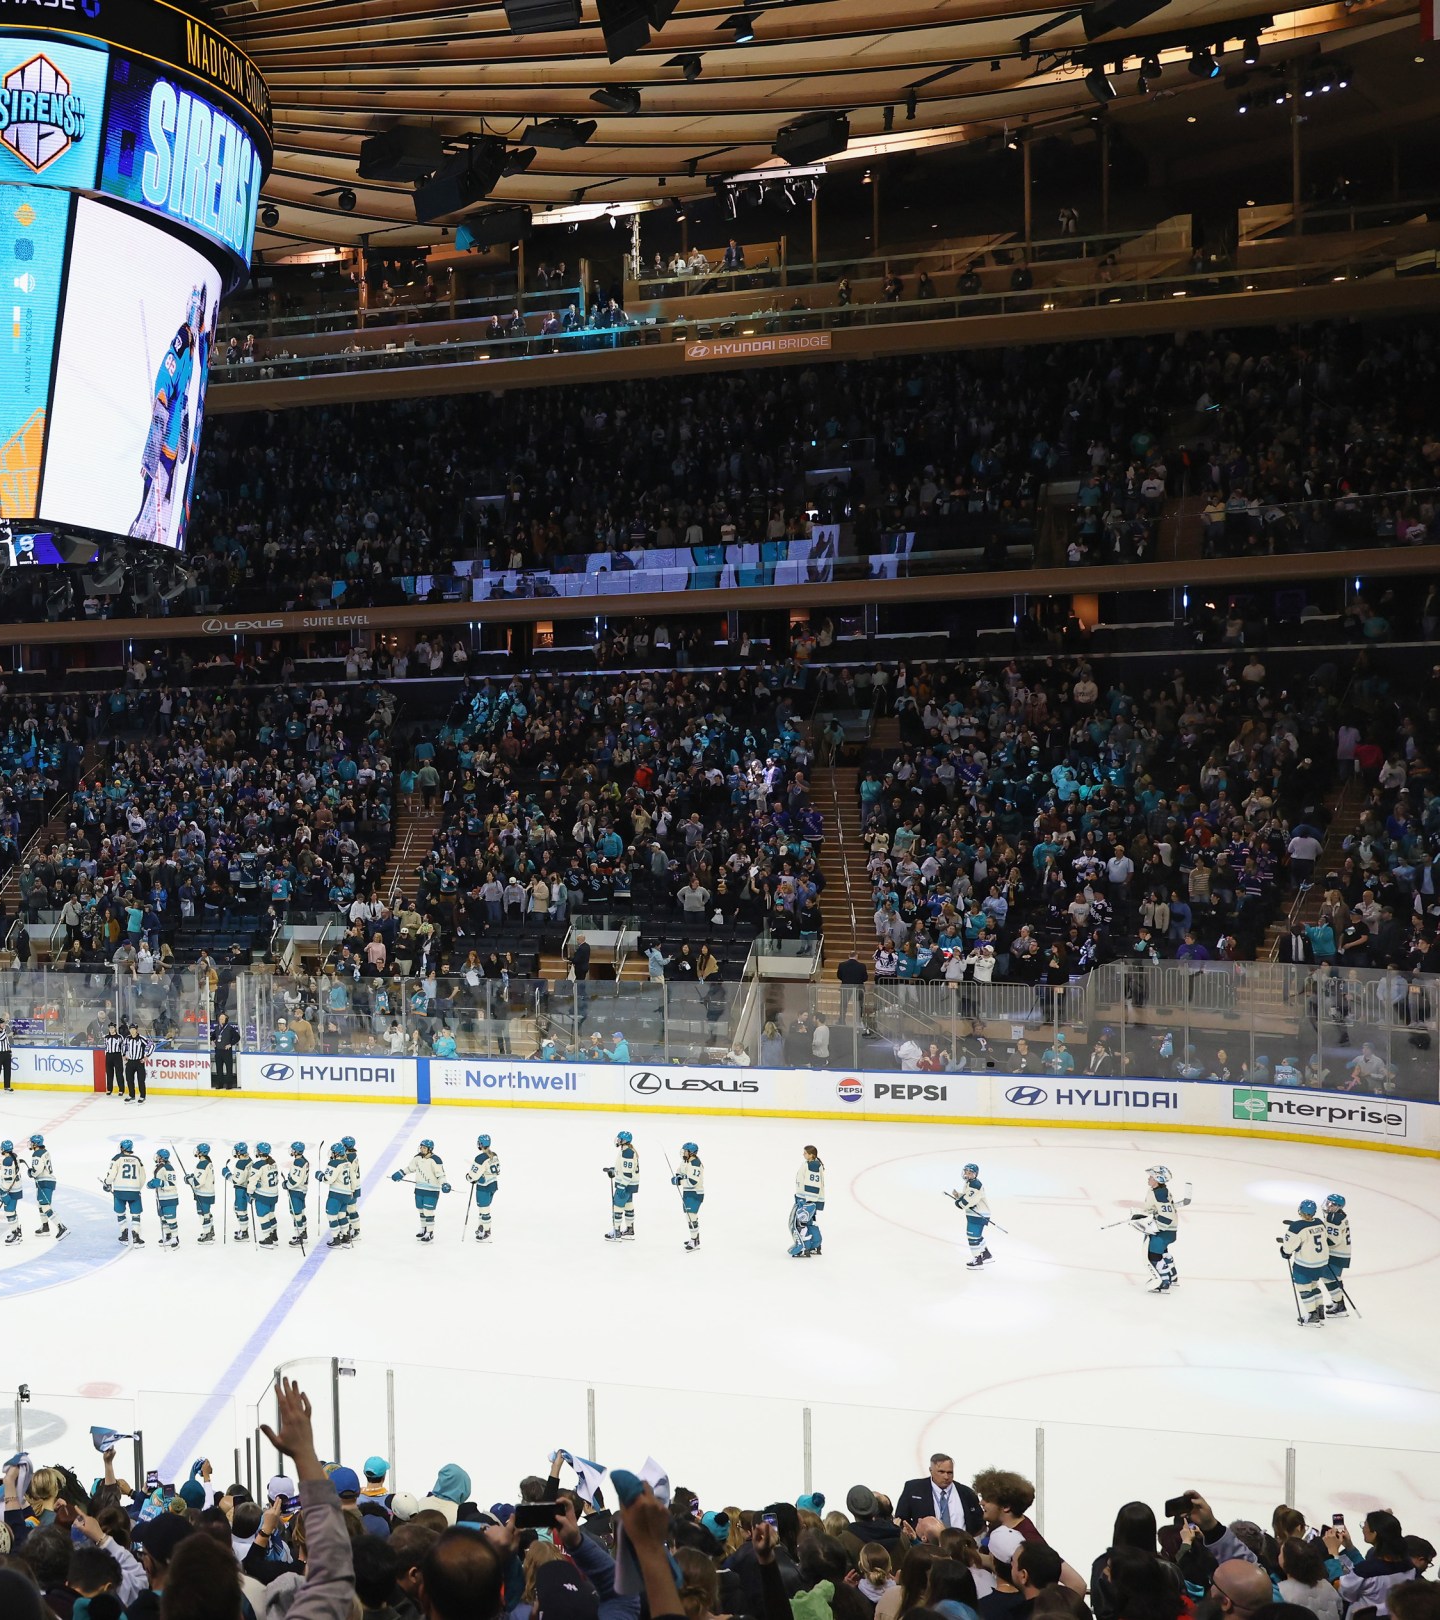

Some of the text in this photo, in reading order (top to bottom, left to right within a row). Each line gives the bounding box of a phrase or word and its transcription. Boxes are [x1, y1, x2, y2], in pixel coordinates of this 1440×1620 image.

[186, 19, 244, 97] MADISON
[714, 335, 830, 355] HYUNDAI BRIDGE
[24, 384, 31, 394] W
[224, 615, 370, 631] LEXUS SUITE LEVEL
[34, 1054, 84, 1075] Infosys
[156, 1059, 177, 1068] FOR
[160, 1070, 200, 1080] DUNKIN'
[300, 1065, 395, 1083] HYUNDAI
[464, 1070, 578, 1091] Northwell
[665, 1079, 759, 1093] LEXUS
[874, 1083, 947, 1101] PEPSI
[1056, 1089, 1178, 1109] HYUNDAI
[1244, 1097, 1403, 1126] enterprise
[122, 1163, 137, 1180] 21
[622, 1160, 633, 1169] 88
[809, 1173, 820, 1183] 83
[1161, 1205, 1173, 1213] 30
[1327, 1226, 1340, 1237] 25
[1313, 1235, 1323, 1253] 5
